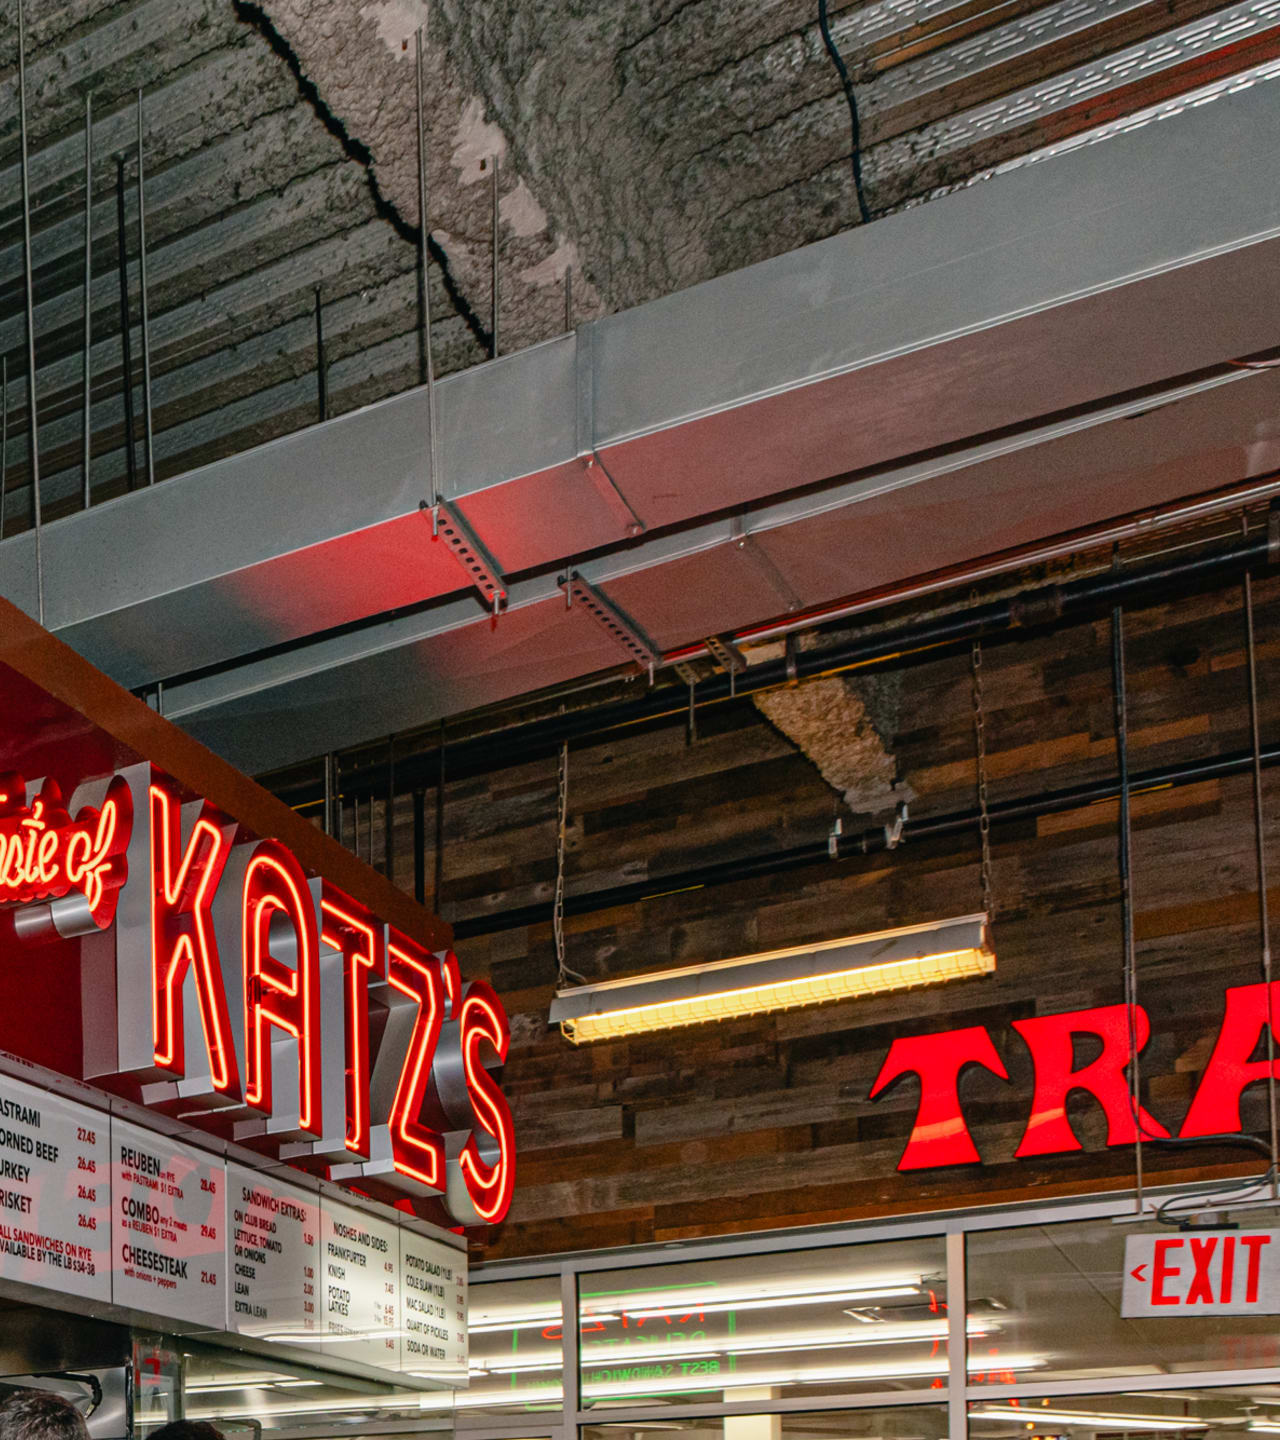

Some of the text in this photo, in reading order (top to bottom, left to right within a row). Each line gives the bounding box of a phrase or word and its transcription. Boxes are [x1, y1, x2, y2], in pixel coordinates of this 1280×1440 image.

[66, 797, 122, 918] of
[149, 762, 515, 1224] KATZ'S
[77, 1127, 96, 1145] 27.45
[35, 1141, 59, 1163] BEEF
[77, 1156, 96, 1173] 26.45
[121, 1146, 160, 1177] REUBEN
[78, 1185, 96, 1202] 26.45
[133, 1172, 159, 1191] PASTRAMI
[168, 1185, 184, 1200] EXTRA
[122, 1196, 159, 1224] COMBO
[242, 1187, 279, 1213] SANDWICH
[78, 1214, 96, 1231] 26.45
[132, 1220, 153, 1235] REUBEN
[161, 1229, 177, 1242] EXTRA
[234, 1210, 243, 1222] ON
[244, 1213, 258, 1227] CLUB
[259, 1217, 277, 1233] BREAD
[333, 1221, 357, 1242] NOSHES
[358, 1231, 370, 1246] AND
[13, 1228, 63, 1254] SANDWICHES
[65, 1242, 76, 1257] ON
[78, 1246, 91, 1261] RYE
[235, 1244, 243, 1256] OR
[244, 1248, 266, 1264] ONIONS
[260, 1237, 282, 1253] TOMATO
[328, 1242, 366, 1267] FRANKFURTER
[37, 1249, 47, 1263] BY
[48, 1251, 62, 1267] THE
[64, 1255, 72, 1270] LB
[122, 1244, 188, 1279] CHEESESTEAK
[406, 1254, 440, 1277] POTATO SALAD
[235, 1263, 255, 1279] CHEESE
[328, 1263, 345, 1280] KNISH
[1151, 1235, 1271, 1306] EXIT
[235, 1281, 249, 1296] LEAN
[328, 1285, 350, 1303] POTATO
[406, 1274, 432, 1294] COLE SLAW
[235, 1300, 267, 1319] EXTRA LEAN
[328, 1299, 348, 1316] LATKES
[406, 1296, 434, 1316] MAC SALAD
[407, 1318, 422, 1333] QUART
[423, 1323, 430, 1334] OF
[430, 1326, 449, 1341] PICKLES
[407, 1339, 420, 1353] SODA
[422, 1344, 428, 1356] OR
[429, 1346, 446, 1360] WATER
